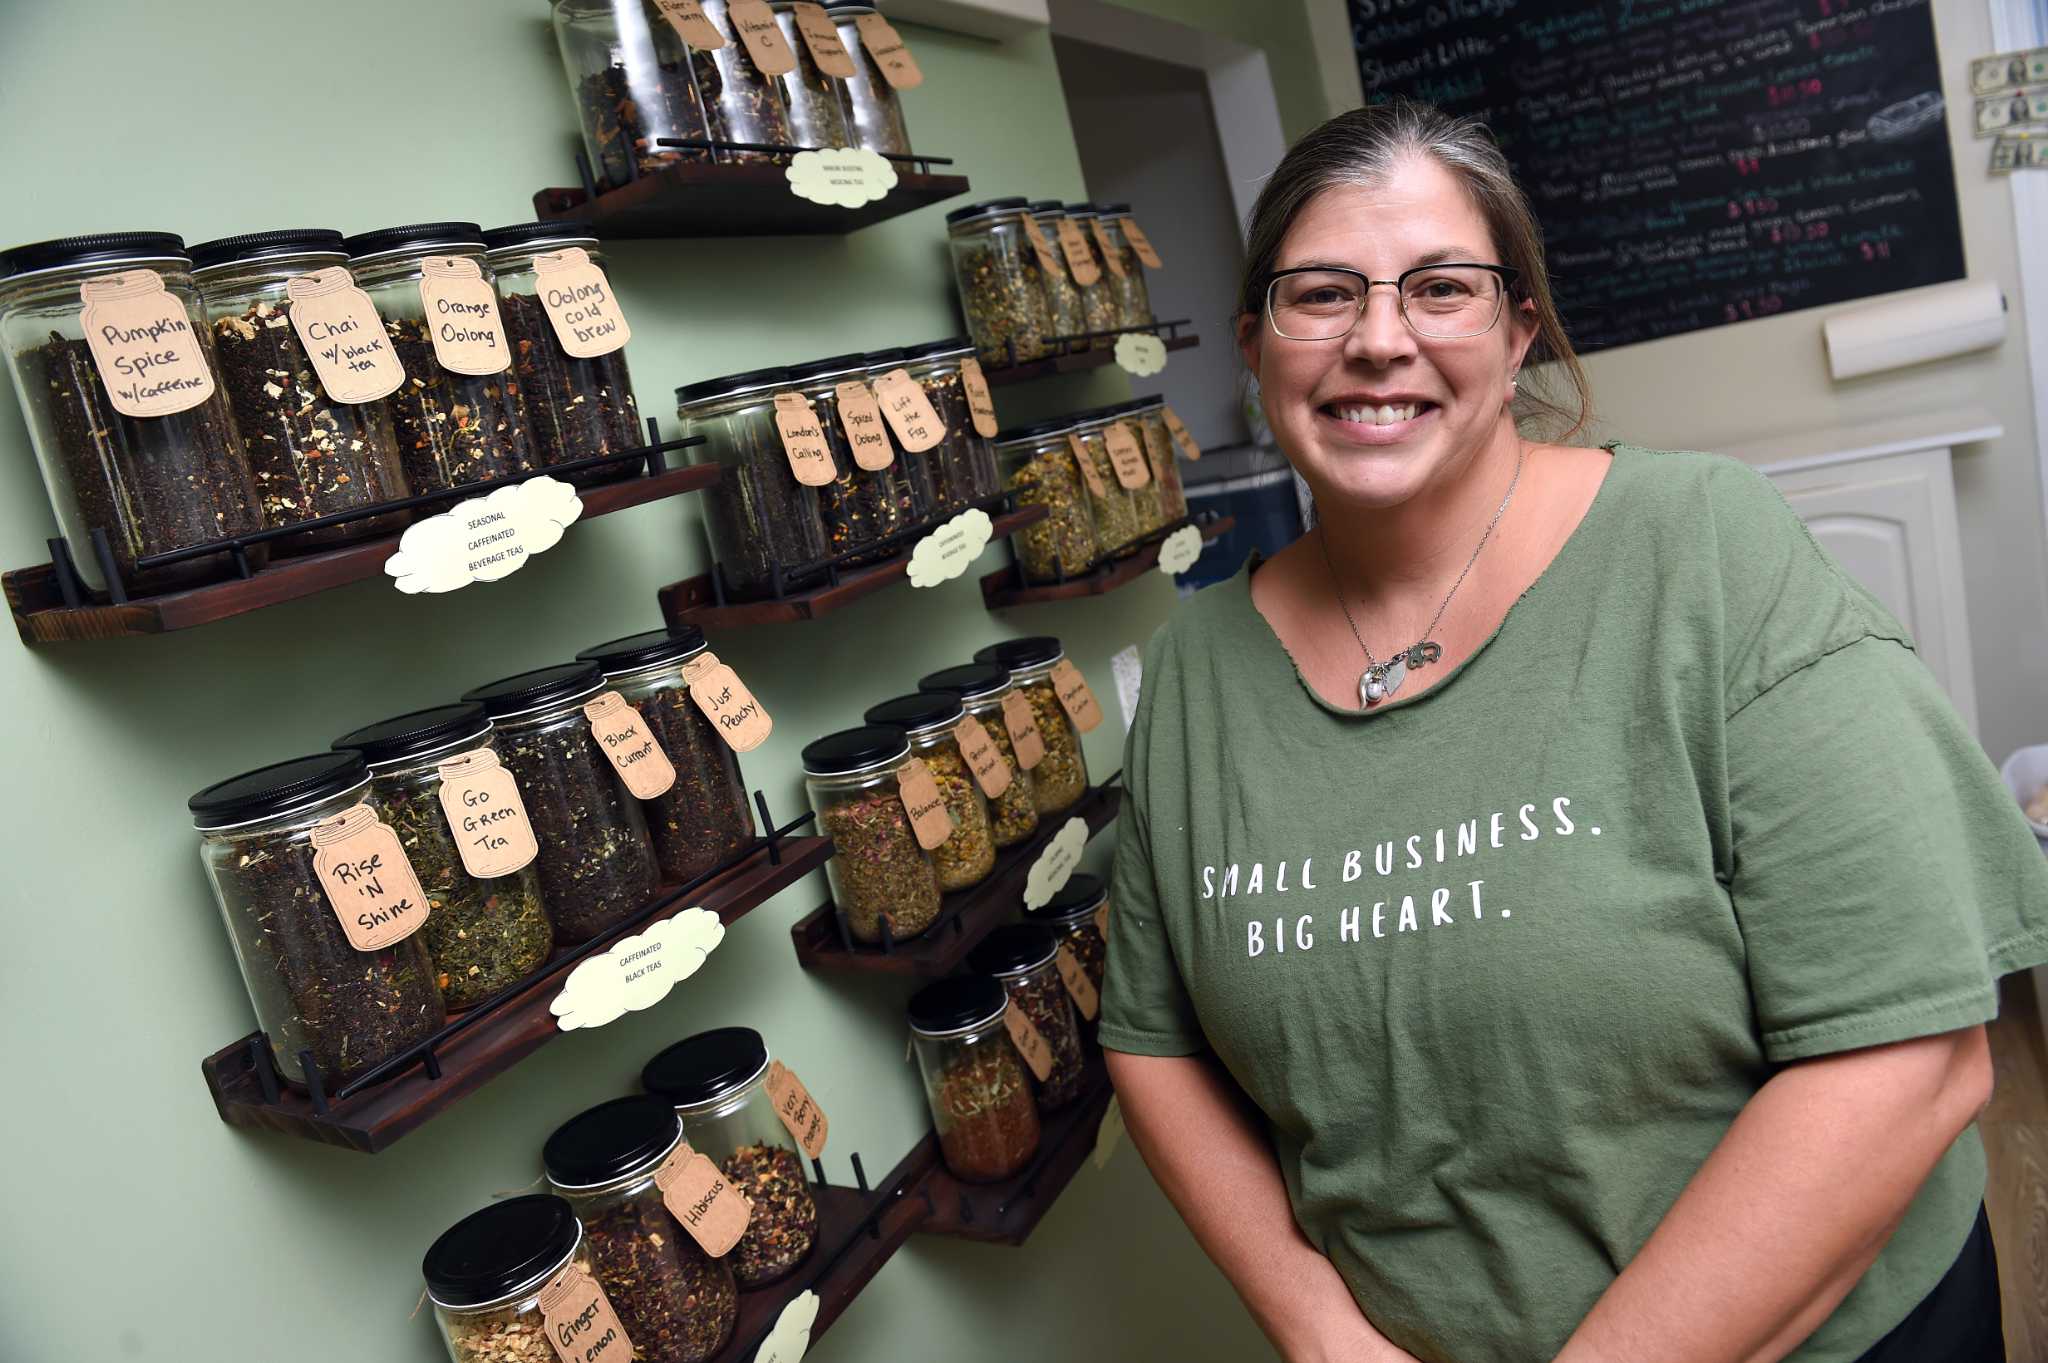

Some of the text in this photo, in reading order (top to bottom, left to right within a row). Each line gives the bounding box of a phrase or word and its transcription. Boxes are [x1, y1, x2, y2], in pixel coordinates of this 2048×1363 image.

[740, 20, 778, 33] Vitamin
[760, 35, 773, 47] C
[548, 282, 605, 308] Oolong
[437, 299, 490, 318] Orange
[565, 303, 601, 324] cold
[102, 319, 186, 345] Pumpkin
[308, 314, 359, 340] Chai
[441, 323, 495, 347] Oolong
[573, 319, 616, 343] brew
[114, 350, 180, 378] Spice
[321, 339, 382, 365] w/ black
[348, 360, 376, 372] tea
[892, 396, 912, 413] Lift
[847, 411, 874, 426] Spiced
[903, 411, 921, 424] the
[786, 422, 820, 438] London's
[854, 433, 883, 448] Oolong
[908, 426, 928, 441] Fog
[792, 447, 824, 462] Calling
[467, 511, 507, 530] SEASONAL
[468, 528, 515, 551] CAFFEINATED
[468, 545, 524, 572] BEVERAGE TEAS
[707, 686, 733, 711] Just
[720, 700, 759, 730] Peachy
[603, 724, 638, 748] Black
[616, 740, 653, 768] Currant
[462, 789, 490, 807] Go
[910, 798, 942, 821] Balance
[473, 835, 509, 851] Tea
[1202, 796, 1601, 900] SMALL BUSINESS.
[332, 853, 383, 885] Rise
[358, 876, 384, 898] 'N
[358, 898, 413, 931] Shine
[1247, 880, 1511, 958] BIG HEART.
[619, 942, 663, 967] CAFFEINATED
[625, 960, 663, 984] BLACK TEAS
[684, 1180, 724, 1228] Hibiscus
[558, 1298, 600, 1348] Ginger
[575, 1328, 617, 1363] emon
